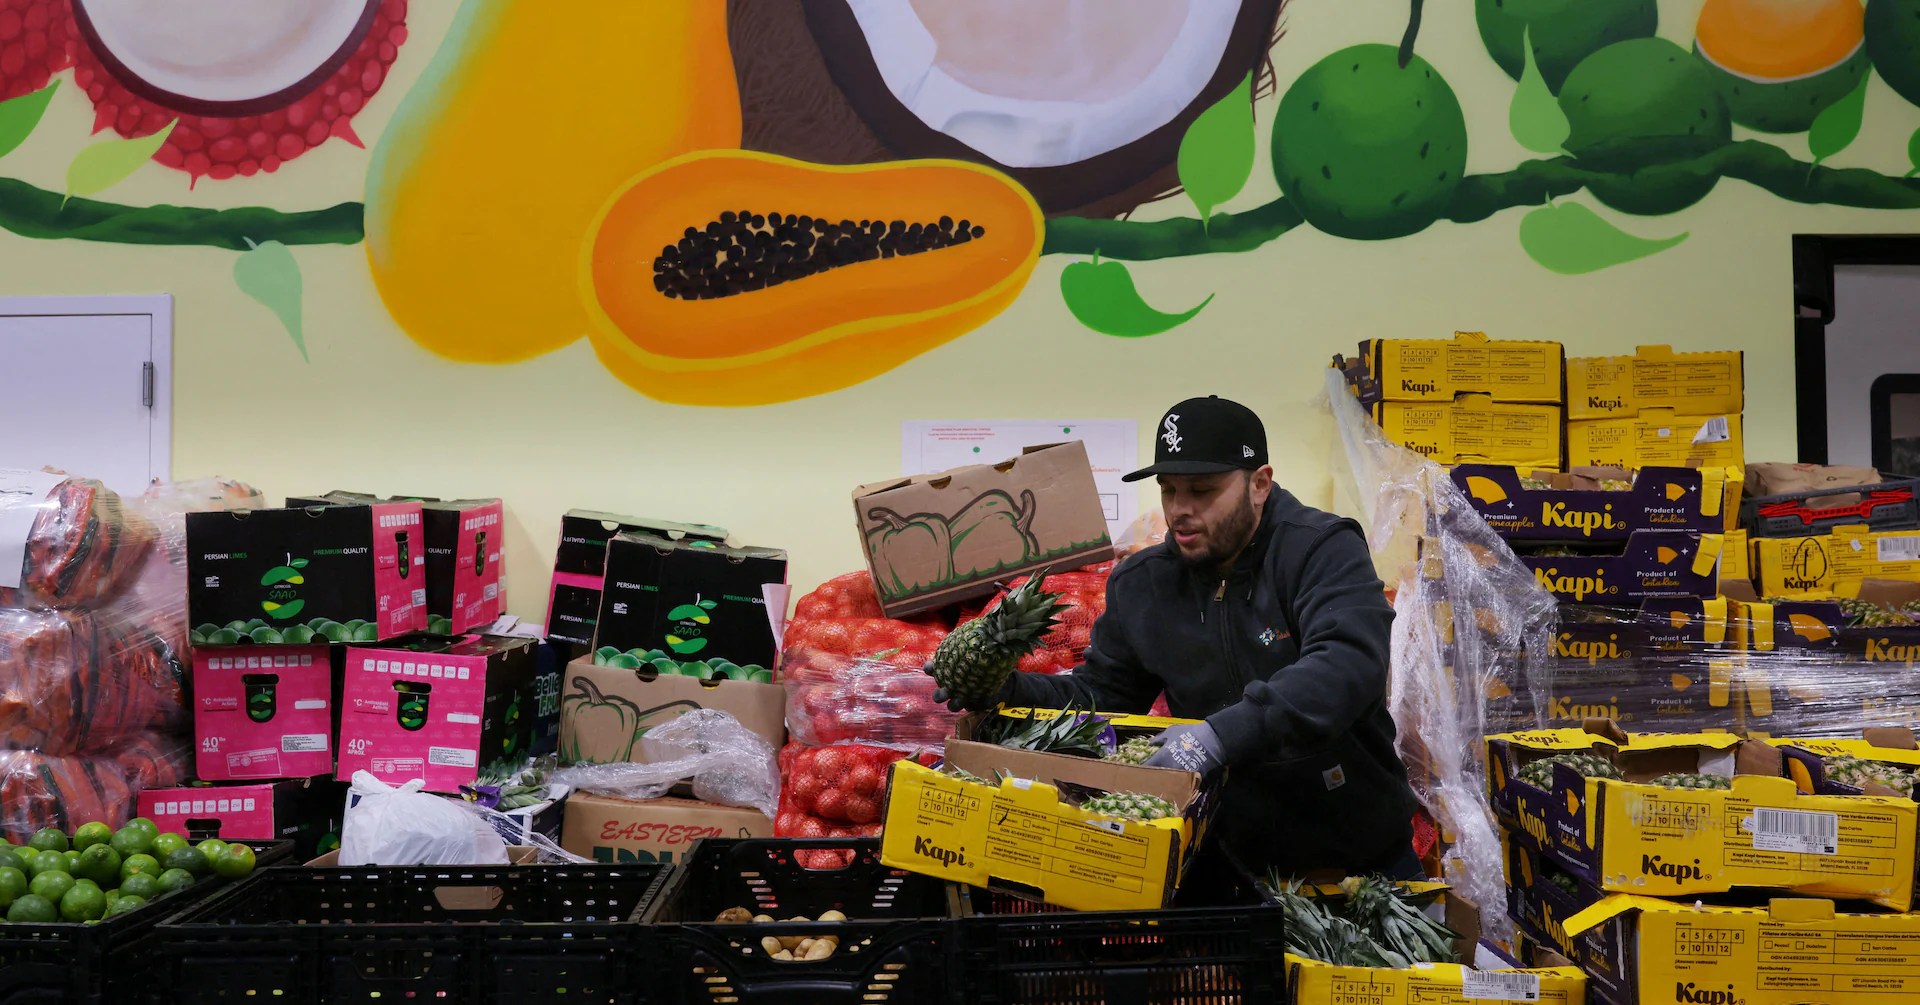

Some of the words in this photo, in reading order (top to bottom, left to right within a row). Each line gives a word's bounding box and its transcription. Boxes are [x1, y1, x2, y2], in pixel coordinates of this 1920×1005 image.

[1402, 380, 1436, 395] Kapi
[1588, 396, 1623, 411] Kapi
[1161, 414, 1182, 452] Sox
[1405, 441, 1439, 456] Kapi
[1487, 516, 1534, 532] pineapples
[1542, 502, 1616, 536] Kapi
[1649, 514, 1668, 523] Costa
[1668, 514, 1686, 523] Rica
[616, 582, 640, 590] PERSIAN
[641, 584, 658, 592] LIMES
[1534, 567, 1608, 601] Kapi
[1784, 576, 1818, 592] Kapi
[723, 594, 751, 602] PREMIUM
[560, 614, 583, 623] PERSIAN
[1548, 632, 1621, 665] Kapi
[1548, 696, 1622, 721] Kapi
[202, 737, 218, 747] 40
[348, 739, 365, 750] 40
[1512, 734, 1562, 746] Kapi
[1792, 740, 1845, 754] Kapi
[282, 826, 298, 834] PERSIAN
[1517, 796, 1549, 851] Kapi
[1558, 820, 1574, 835] Product
[1575, 829, 1580, 838] of
[600, 820, 722, 844] EASTERN
[914, 835, 966, 868] Kapi
[1642, 854, 1703, 885] Kapi
[1542, 900, 1576, 958] Kapi
[1676, 982, 1737, 1005] Kapi
